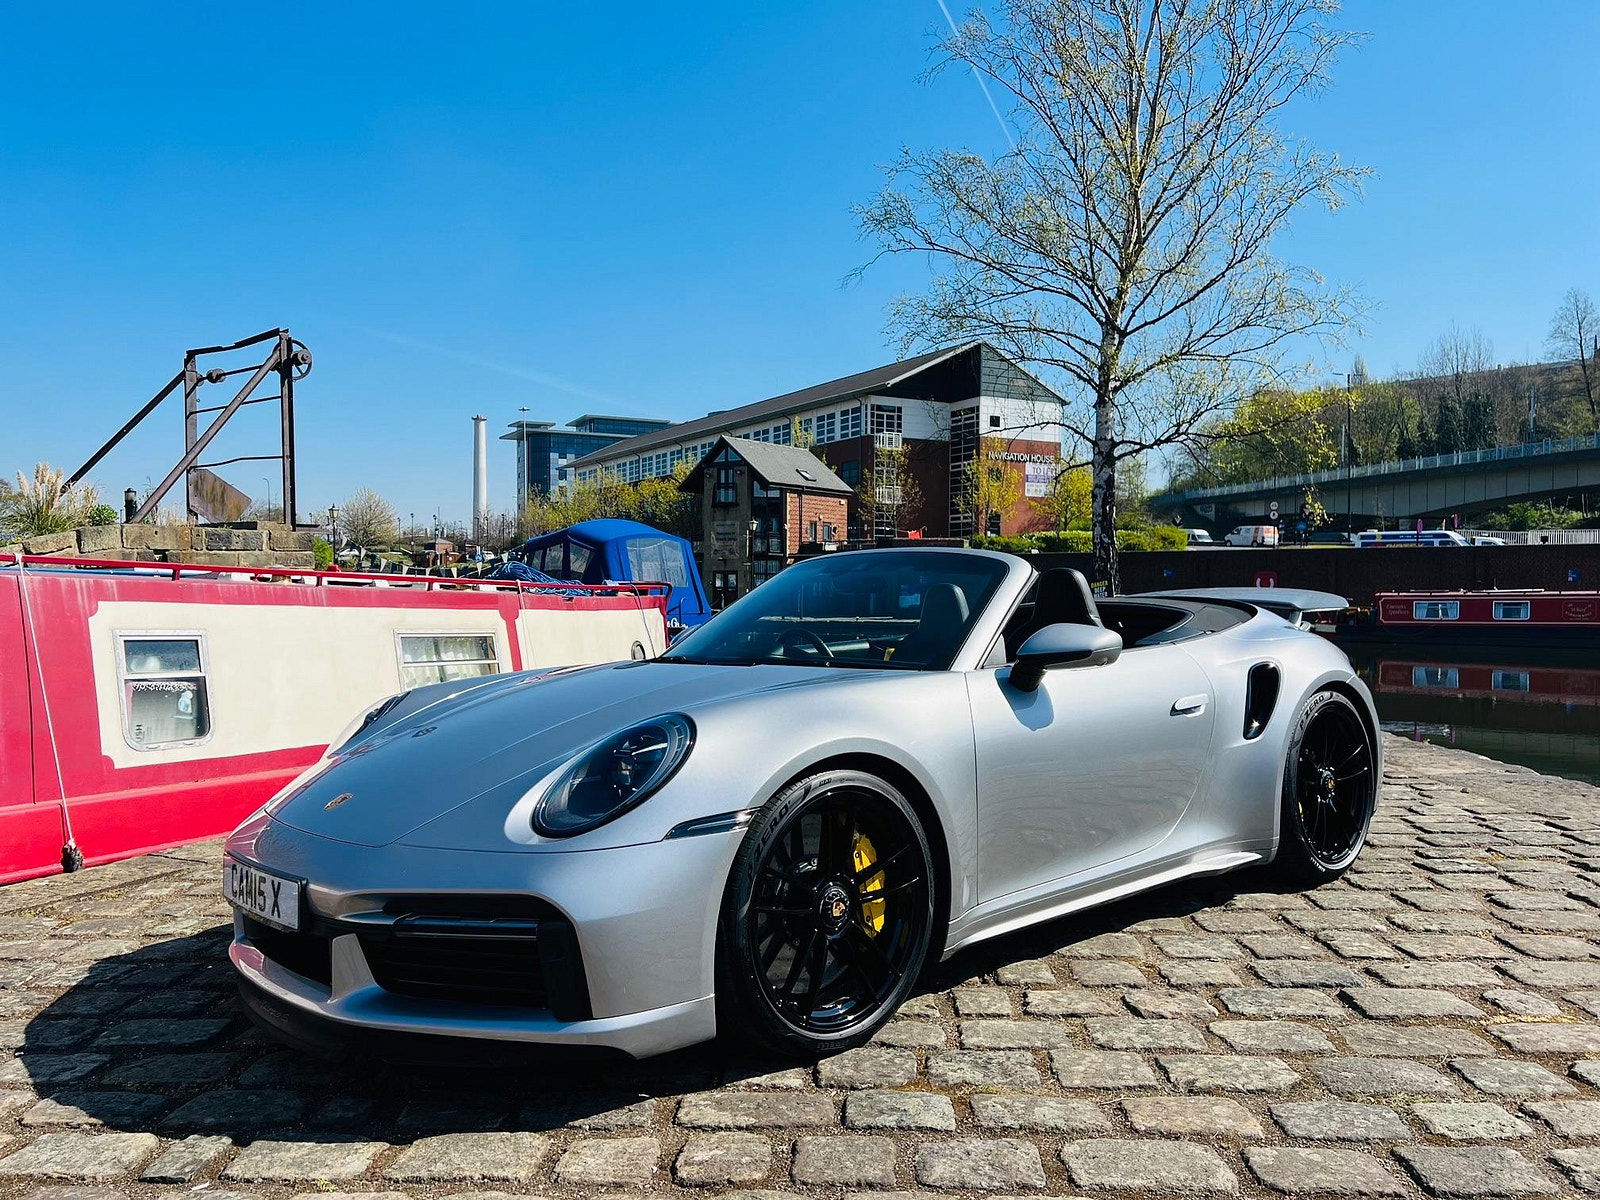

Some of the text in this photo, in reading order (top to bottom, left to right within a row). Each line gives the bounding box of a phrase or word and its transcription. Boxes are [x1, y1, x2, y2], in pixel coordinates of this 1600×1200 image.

[988, 451, 1055, 466] NAVIGATION HOUSE
[1304, 694, 1325, 720] ZERO
[754, 803, 789, 860] ZERO
[271, 879, 281, 918] X
